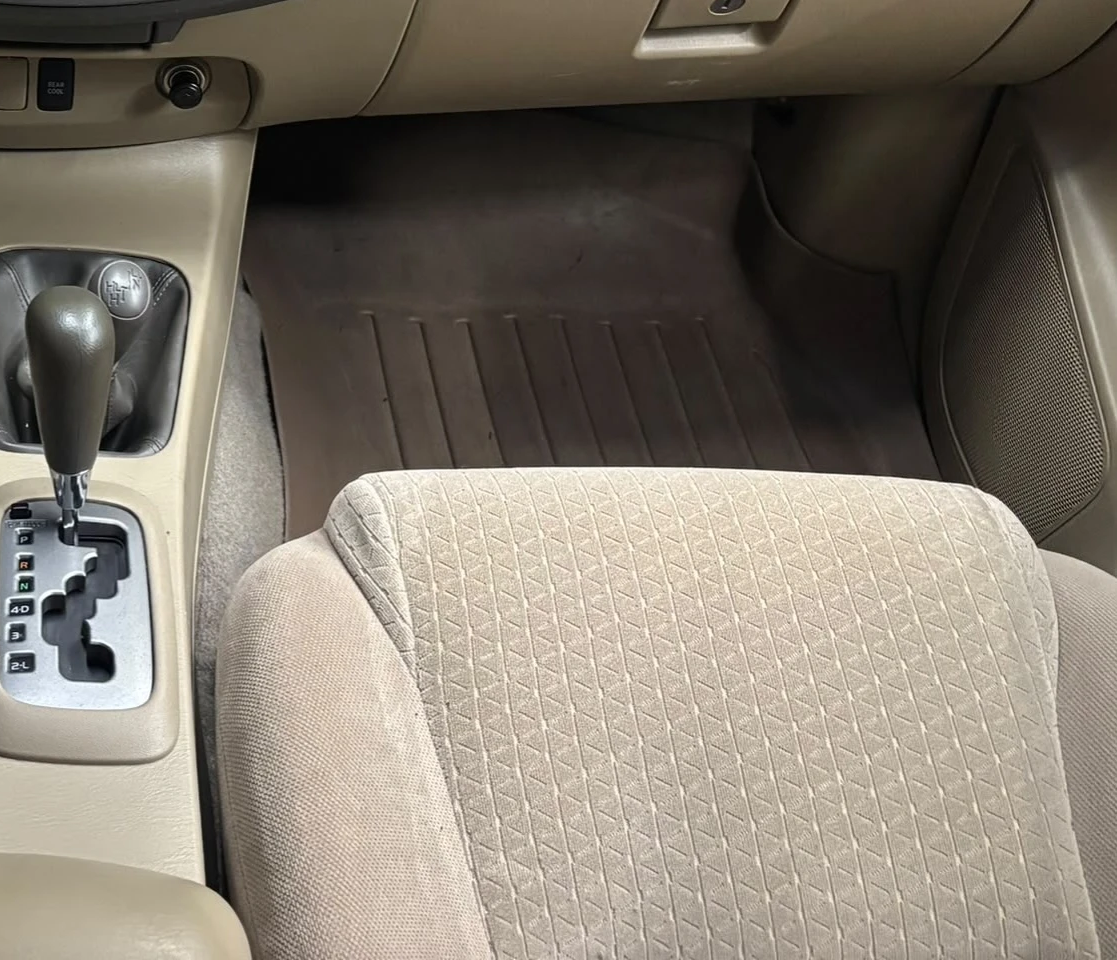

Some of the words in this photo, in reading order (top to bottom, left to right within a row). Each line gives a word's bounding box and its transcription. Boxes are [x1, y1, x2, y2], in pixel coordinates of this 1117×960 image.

[20, 535, 29, 544] P
[20, 561, 29, 569] R
[20, 582, 29, 590] N
